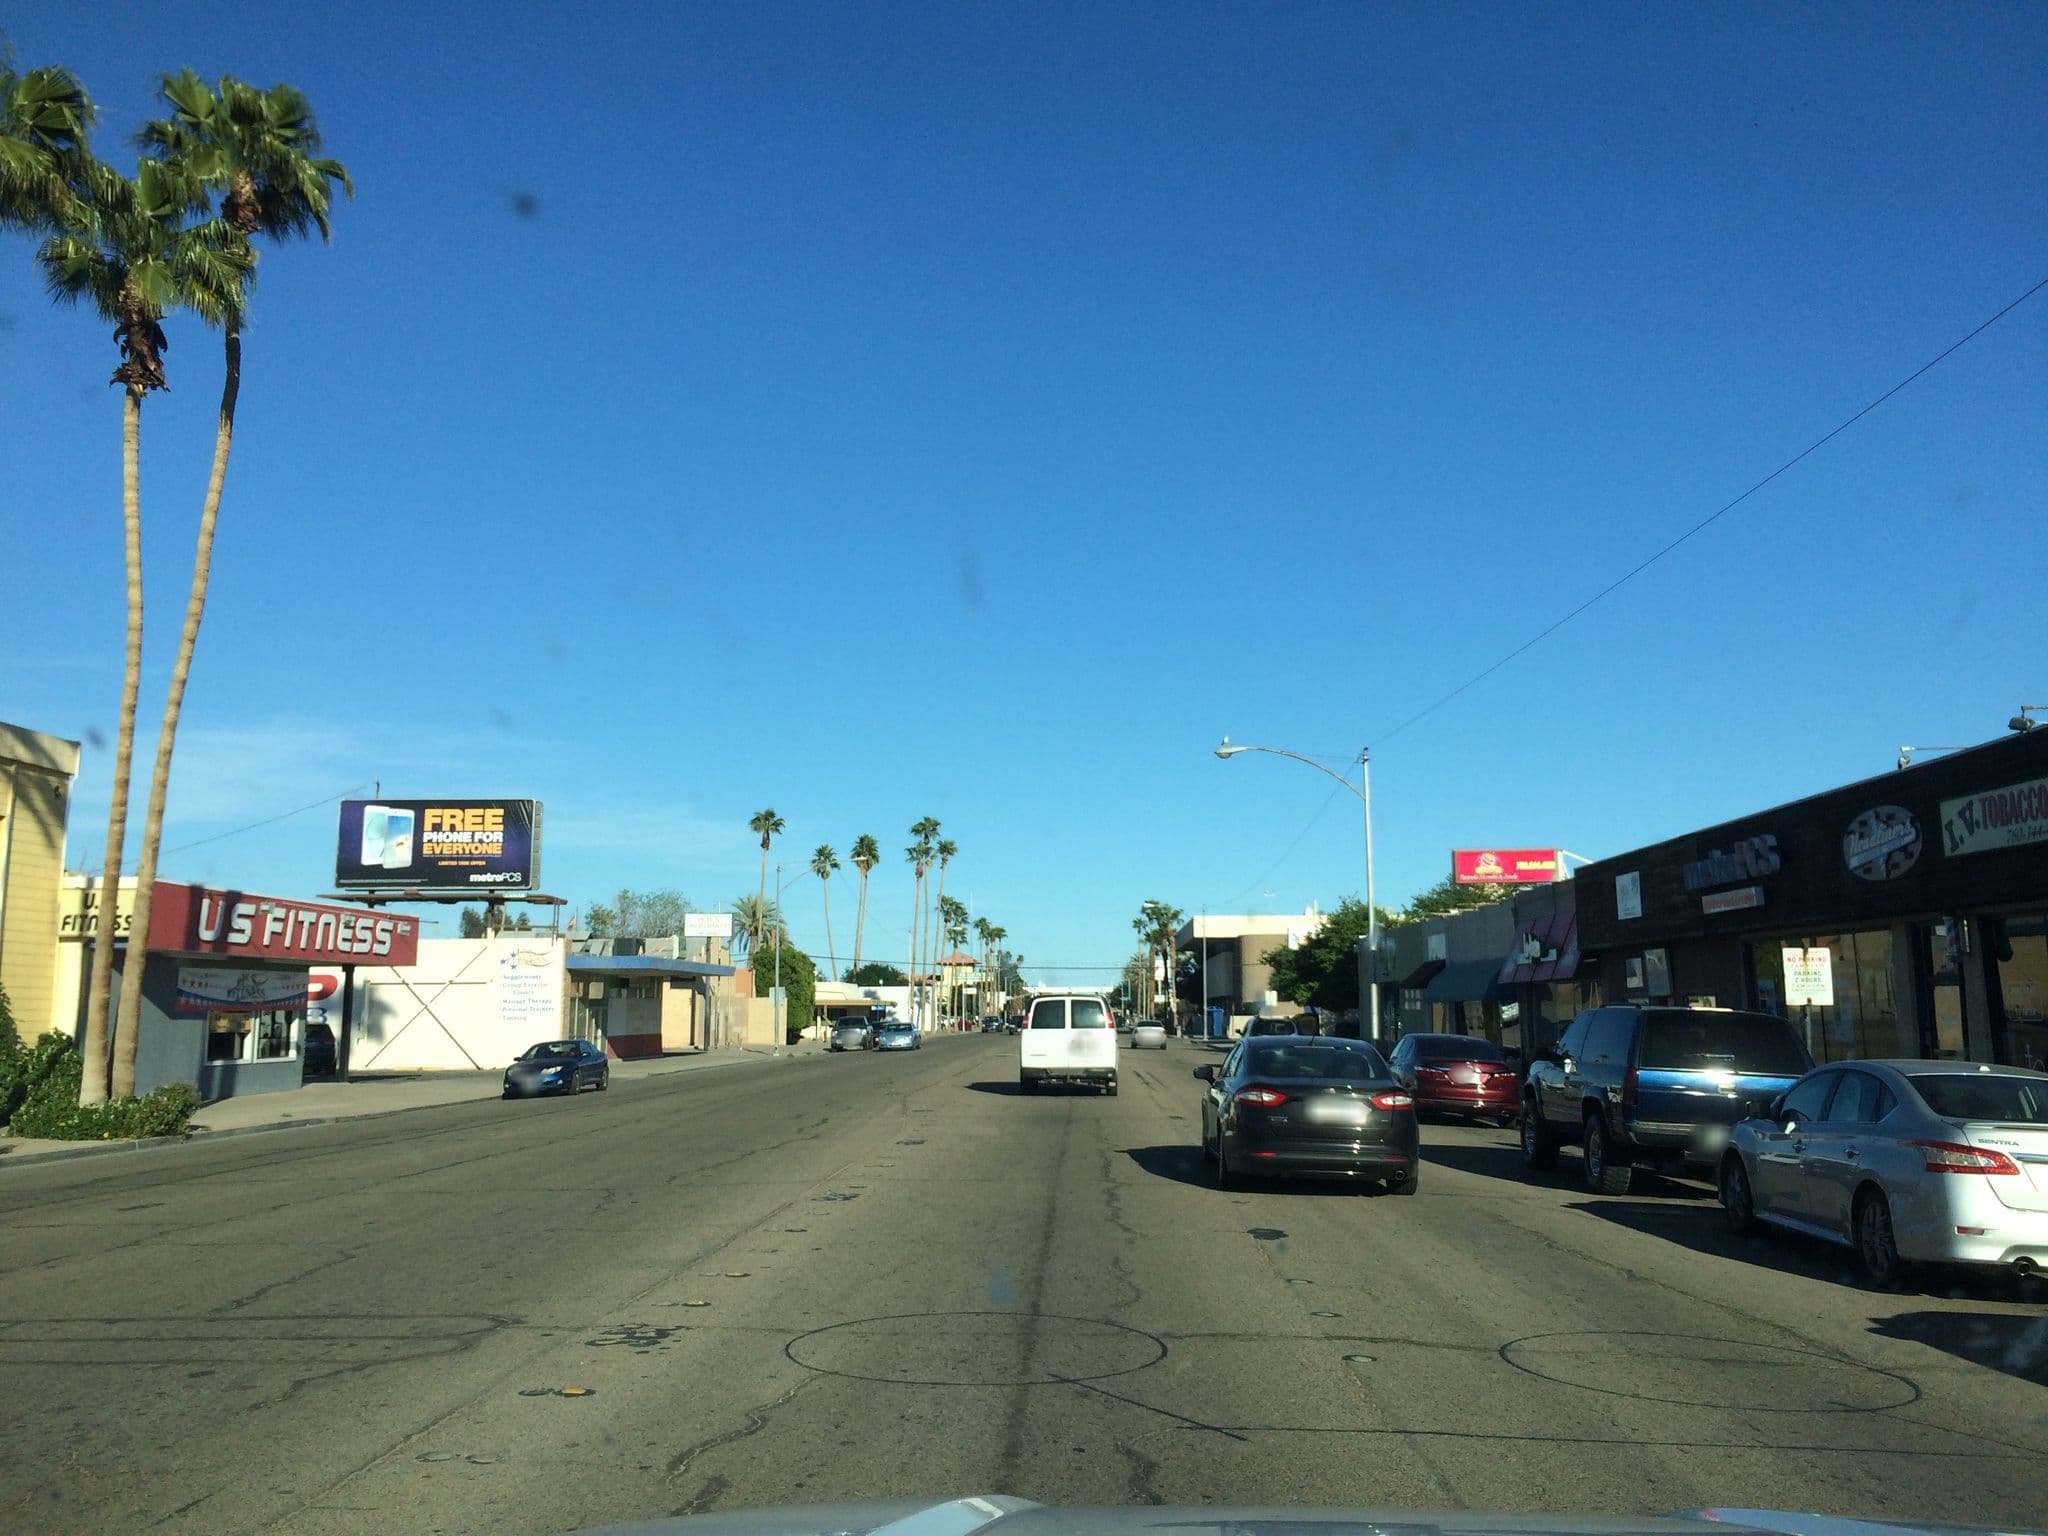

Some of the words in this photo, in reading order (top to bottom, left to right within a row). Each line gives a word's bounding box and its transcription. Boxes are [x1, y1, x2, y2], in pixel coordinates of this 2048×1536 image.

[1979, 784, 2048, 831] TOBACCO
[424, 808, 504, 832] FREE
[423, 831, 473, 843] PHONE
[474, 831, 503, 843] FOR
[422, 843, 503, 855] EVERYONE
[469, 872, 522, 882] metroPCS
[61, 914, 133, 932] FITNSS
[262, 907, 394, 955] FITNESS
[1977, 1138, 2020, 1147] SENTRA
